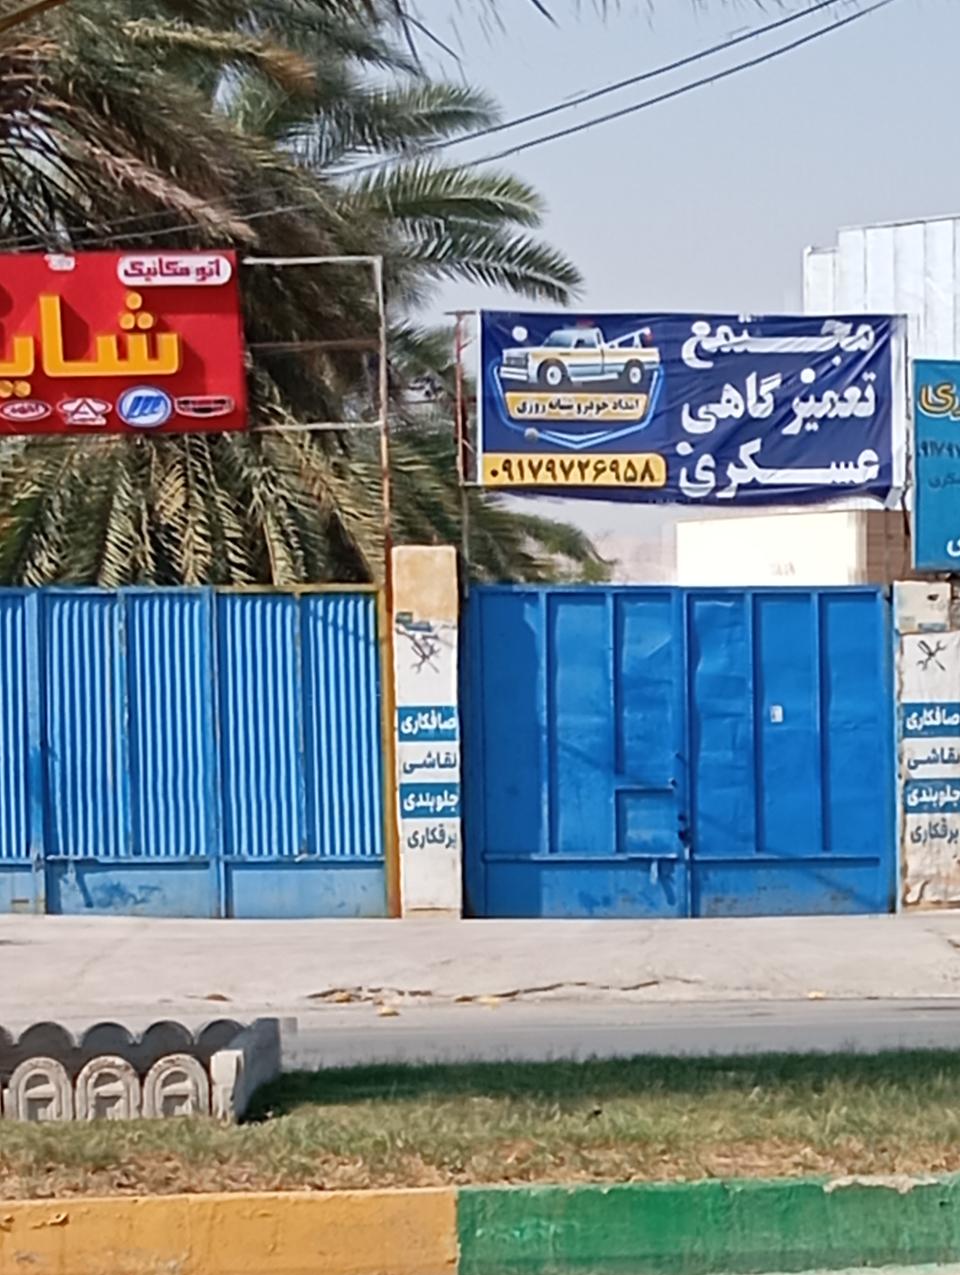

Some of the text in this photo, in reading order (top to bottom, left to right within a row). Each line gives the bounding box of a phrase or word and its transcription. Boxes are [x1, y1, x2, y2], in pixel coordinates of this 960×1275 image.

[123, 257, 221, 282] اتو مکانیک
[490, 458, 655, 482] ۰۹۱۷۹۷۲۶۹۵۸
[679, 438, 879, 498] عسکری
[400, 709, 458, 735] صافکاری
[905, 706, 960, 731] صافکاری
[402, 751, 458, 775] نقاشی
[403, 789, 460, 813] جلوبندی
[910, 817, 960, 845] برقکاری
